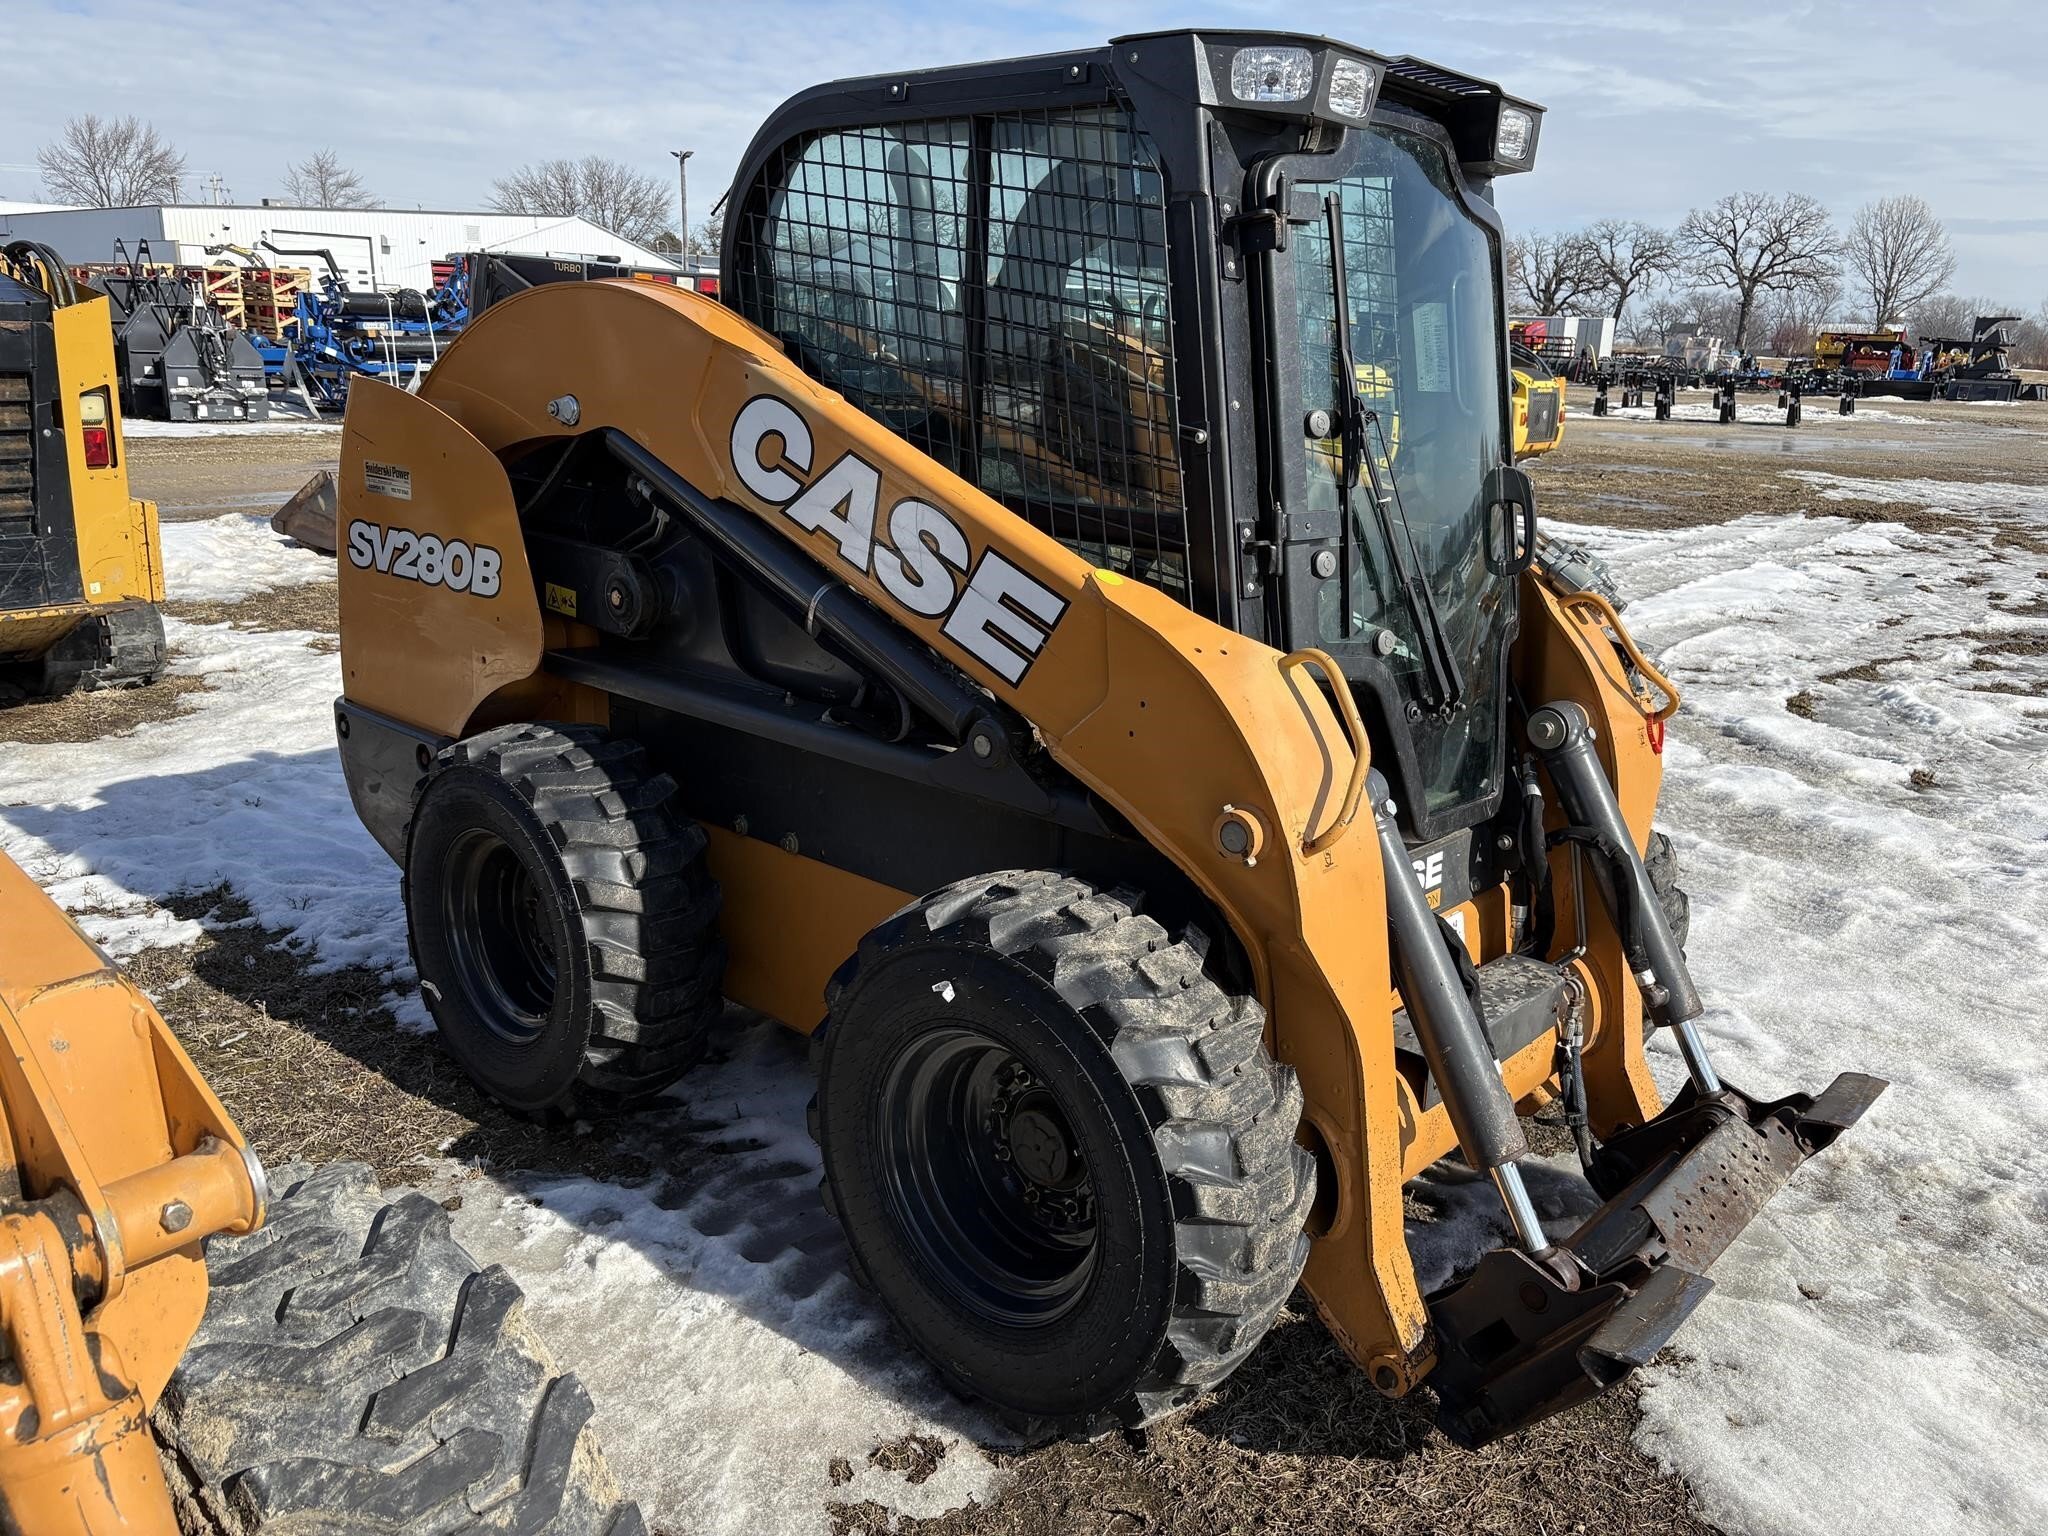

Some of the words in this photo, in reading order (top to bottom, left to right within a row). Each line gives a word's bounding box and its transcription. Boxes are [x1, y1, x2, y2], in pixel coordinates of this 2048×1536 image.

[553, 261, 582, 273] TURBO
[391, 466, 409, 480] Power
[348, 519, 502, 599] SV280B
[730, 394, 1071, 689] CASE
